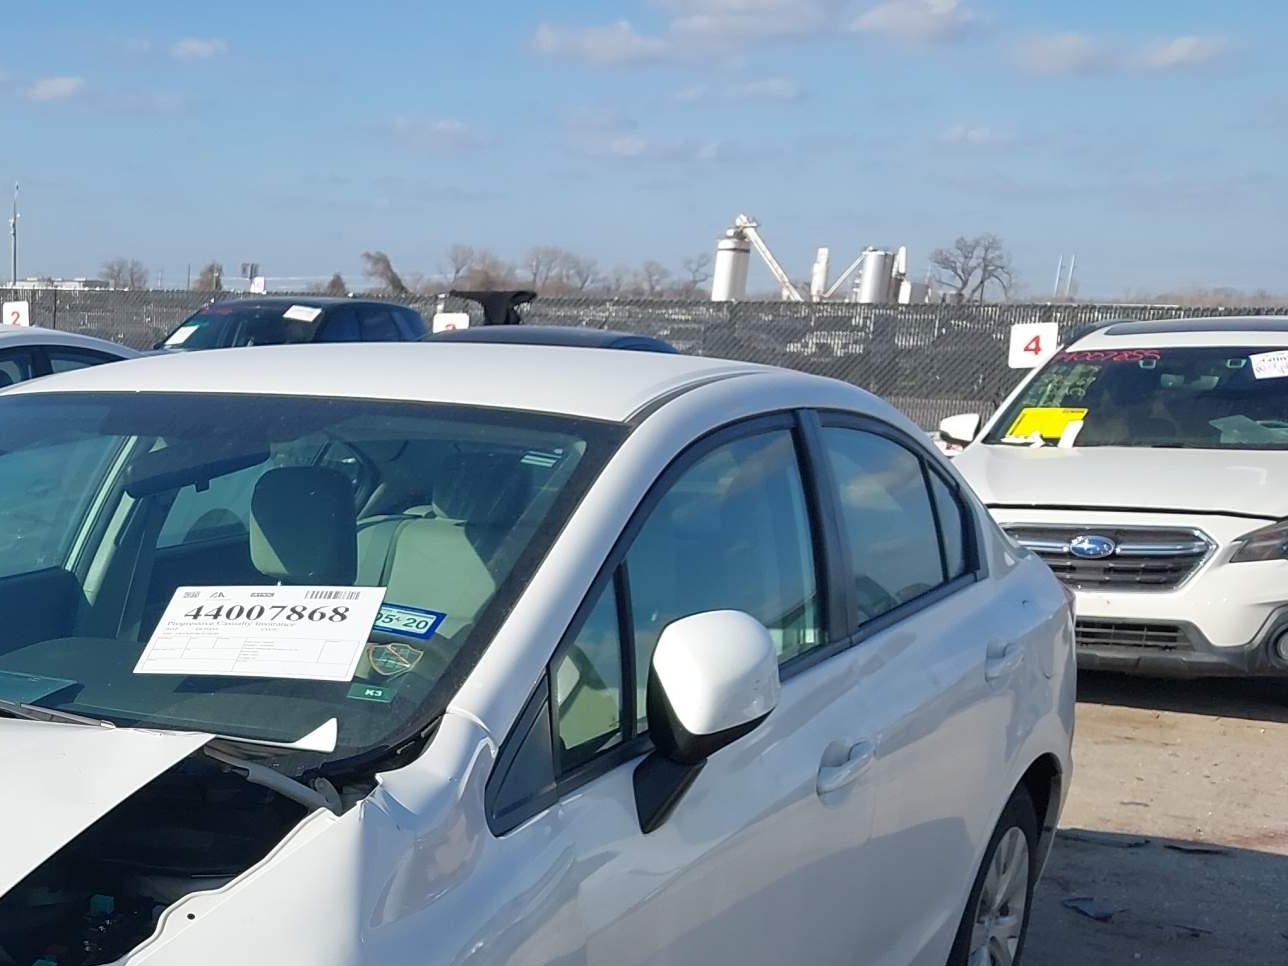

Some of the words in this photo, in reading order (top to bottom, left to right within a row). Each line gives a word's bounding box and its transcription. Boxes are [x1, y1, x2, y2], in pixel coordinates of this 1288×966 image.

[10, 310, 21, 328] 2
[1023, 334, 1042, 356] 4
[183, 604, 350, 623] 44007868
[402, 617, 429, 630] 20
